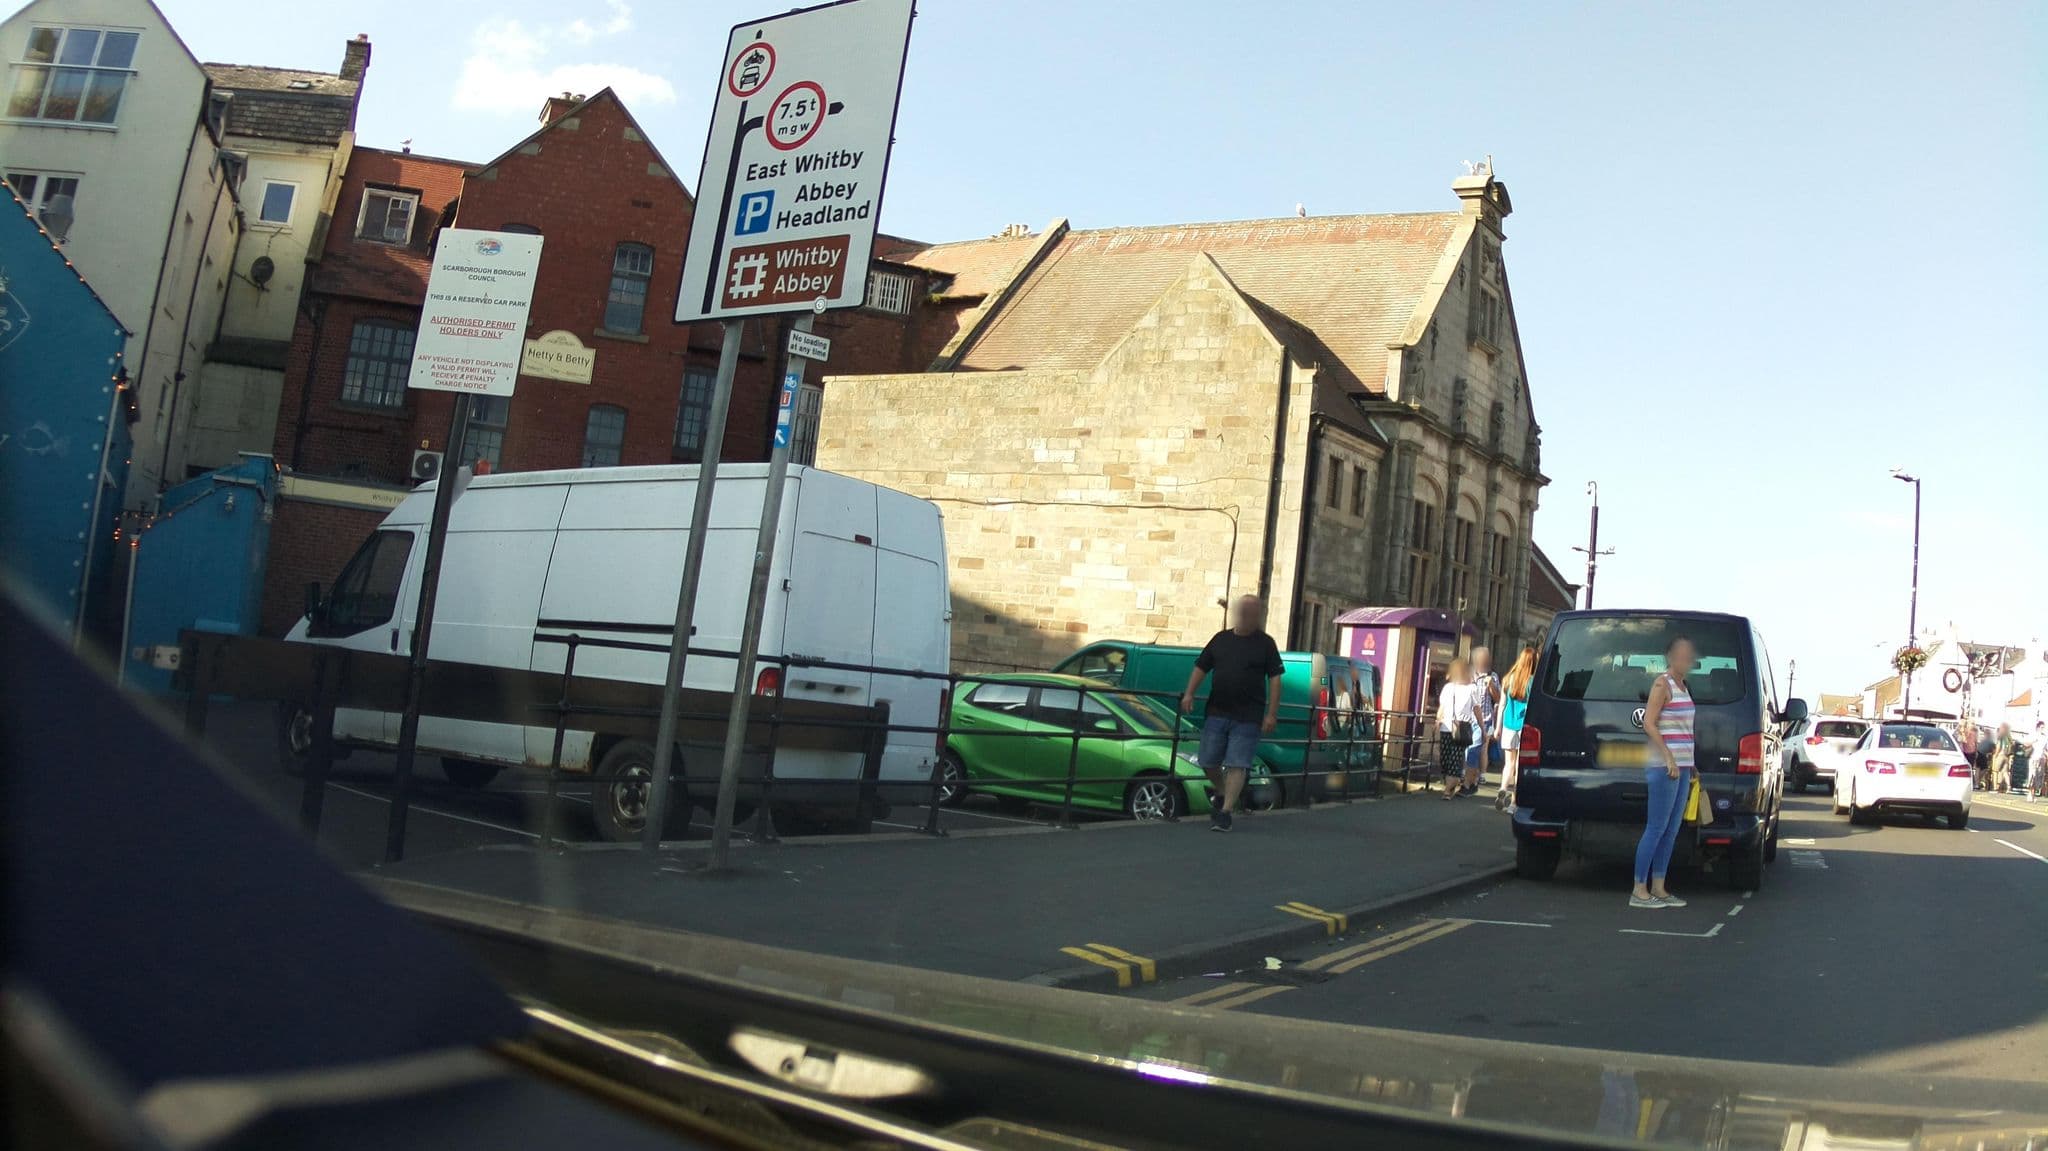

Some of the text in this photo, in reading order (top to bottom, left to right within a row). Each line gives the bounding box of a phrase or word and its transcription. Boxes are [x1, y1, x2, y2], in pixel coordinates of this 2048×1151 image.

[746, 150, 864, 181] East Whitby
[794, 180, 858, 202] Abbey
[744, 196, 870, 231] P Headland
[775, 246, 841, 270] Whitby
[442, 265, 526, 277] SCARBOROUGH BOROUGH
[772, 272, 833, 294] Abbey
[458, 296, 492, 304] RESERVED
[431, 316, 516, 330] AUTHORISED PERMIT
[440, 326, 504, 338] HOLDERS ONLY
[792, 334, 827, 349] No loading
[799, 345, 810, 354] any
[812, 348, 826, 357] time
[476, 360, 514, 368] DISPLAYING
[565, 353, 590, 368] Betty
[465, 374, 495, 383] PENALTY
